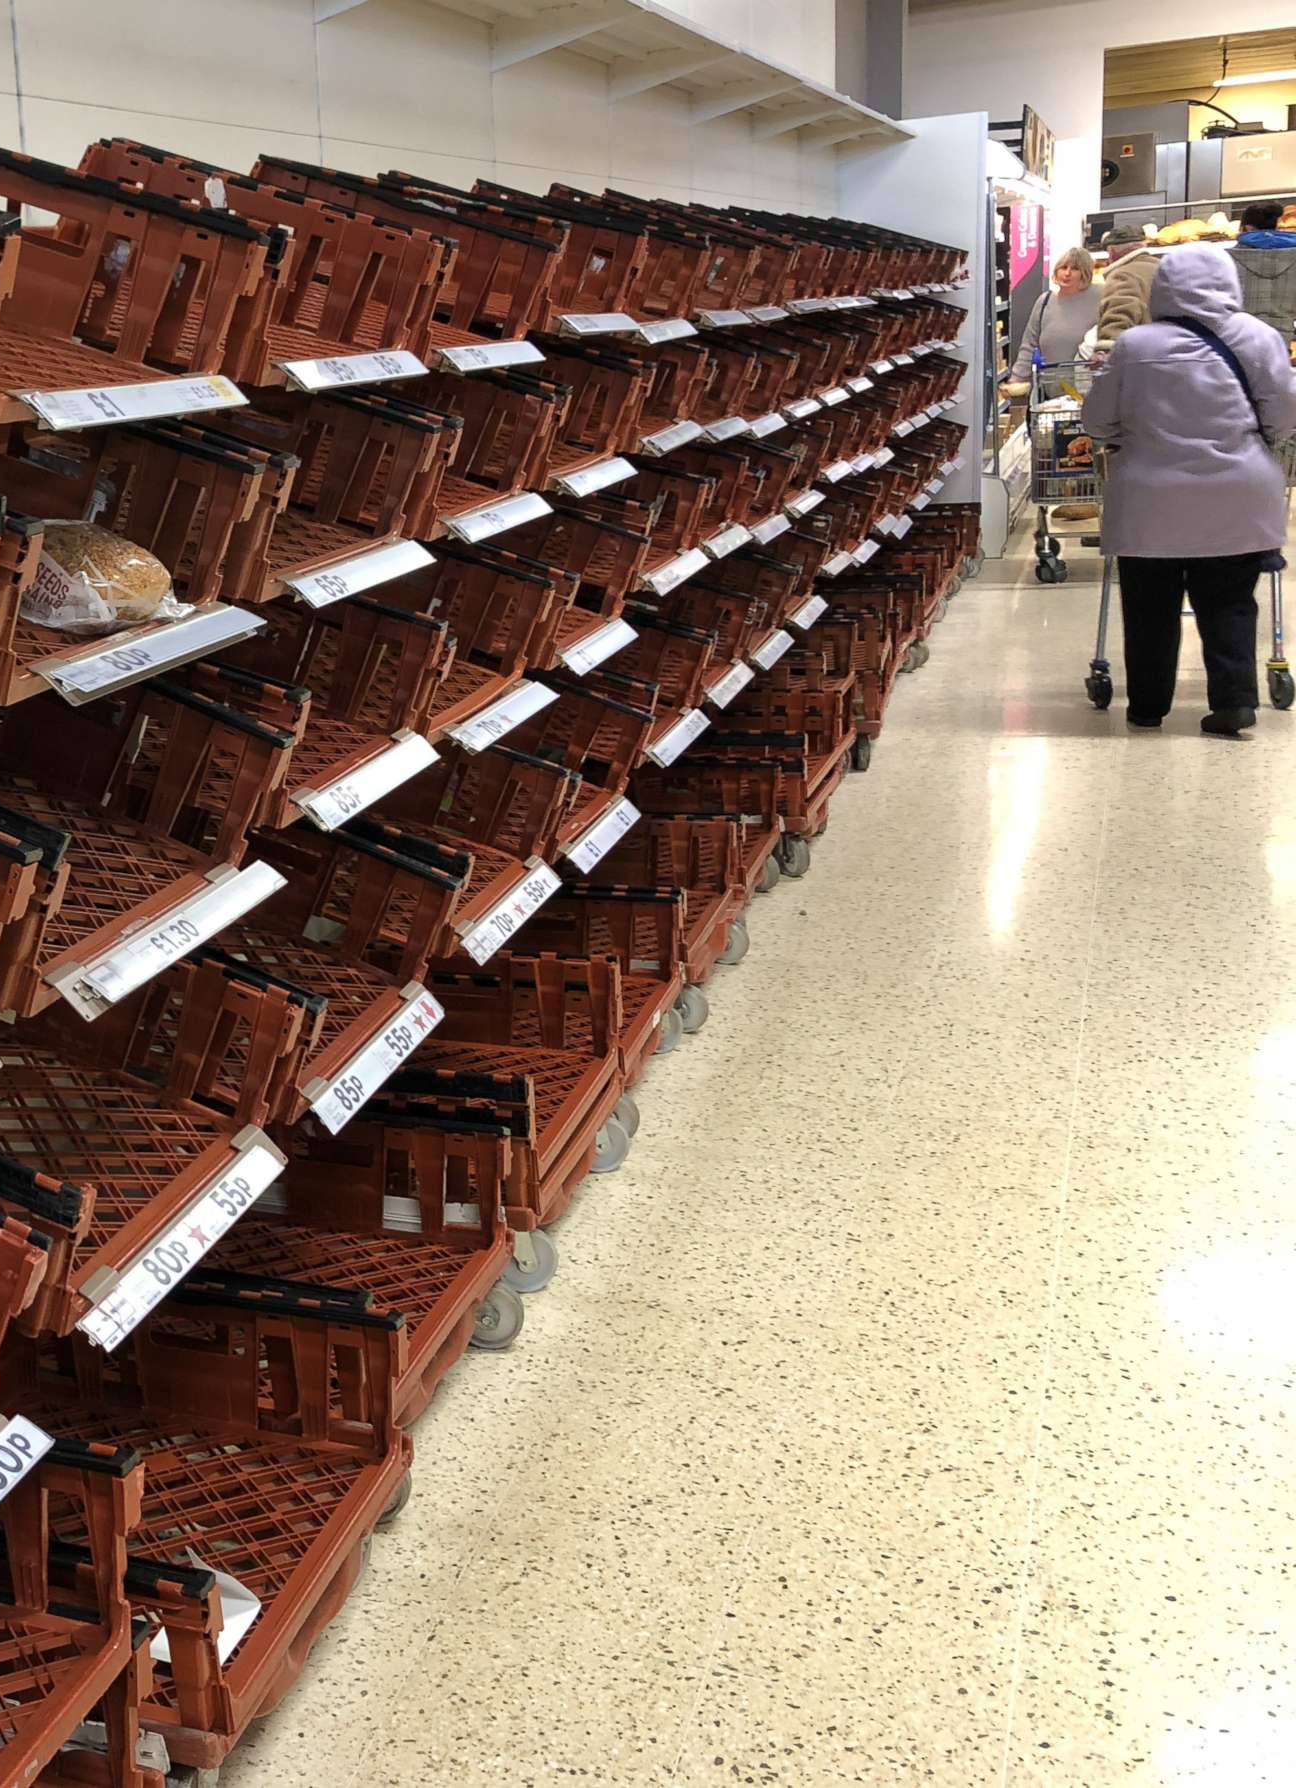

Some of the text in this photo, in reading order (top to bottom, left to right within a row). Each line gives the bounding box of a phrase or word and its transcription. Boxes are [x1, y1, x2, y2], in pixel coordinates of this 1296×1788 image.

[87, 391, 126, 417] £1
[35, 562, 69, 601] SEEDS
[314, 574, 350, 598] 65p
[150, 919, 200, 955] £1.30
[333, 1075, 365, 1111] 85p
[384, 1025, 414, 1057] 55p
[142, 1240, 190, 1286] 80p
[209, 1176, 253, 1217] 55p
